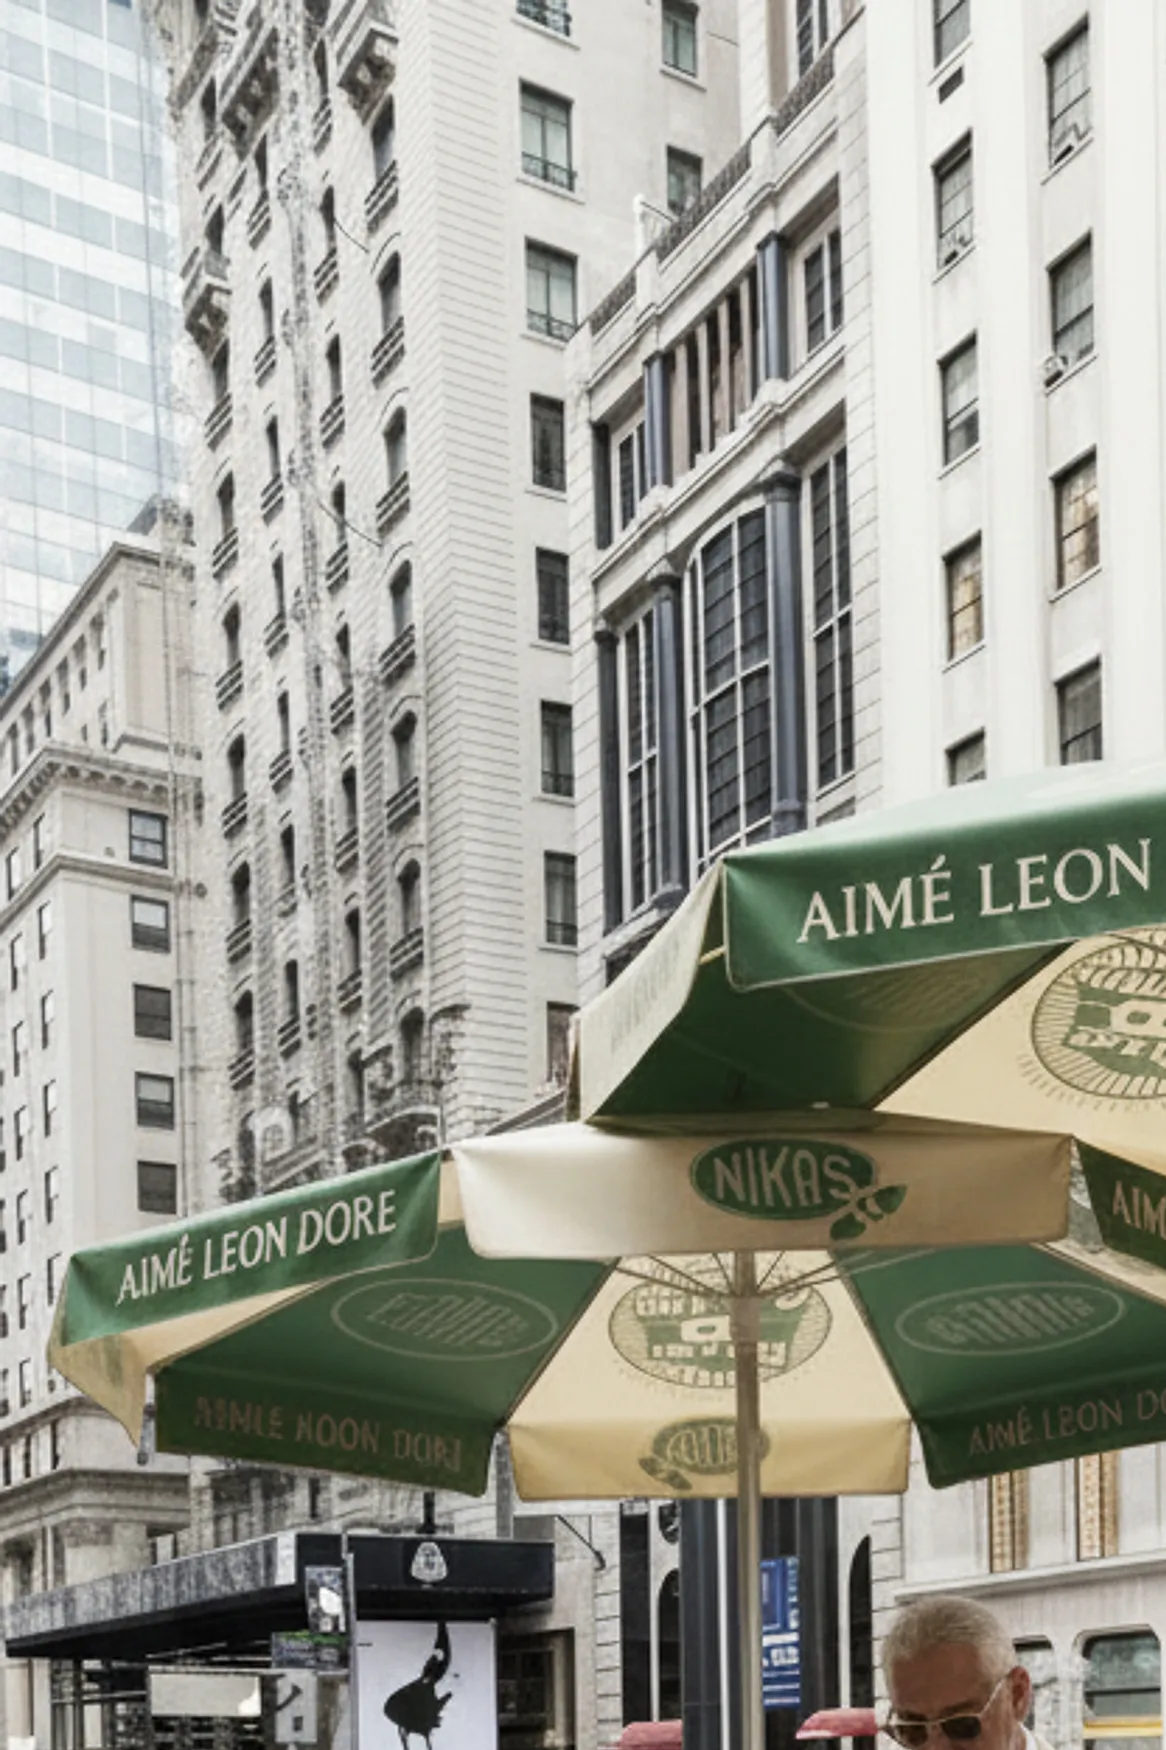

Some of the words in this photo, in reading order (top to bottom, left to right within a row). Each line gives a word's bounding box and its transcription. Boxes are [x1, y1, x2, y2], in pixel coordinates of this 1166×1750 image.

[796, 855, 956, 943] AIMÉ
[979, 838, 1154, 917] LEON
[714, 1146, 859, 1208] NIKAS
[115, 1232, 194, 1307] AIMÉ
[203, 1216, 288, 1280] LEON
[297, 1189, 397, 1255] DORE
